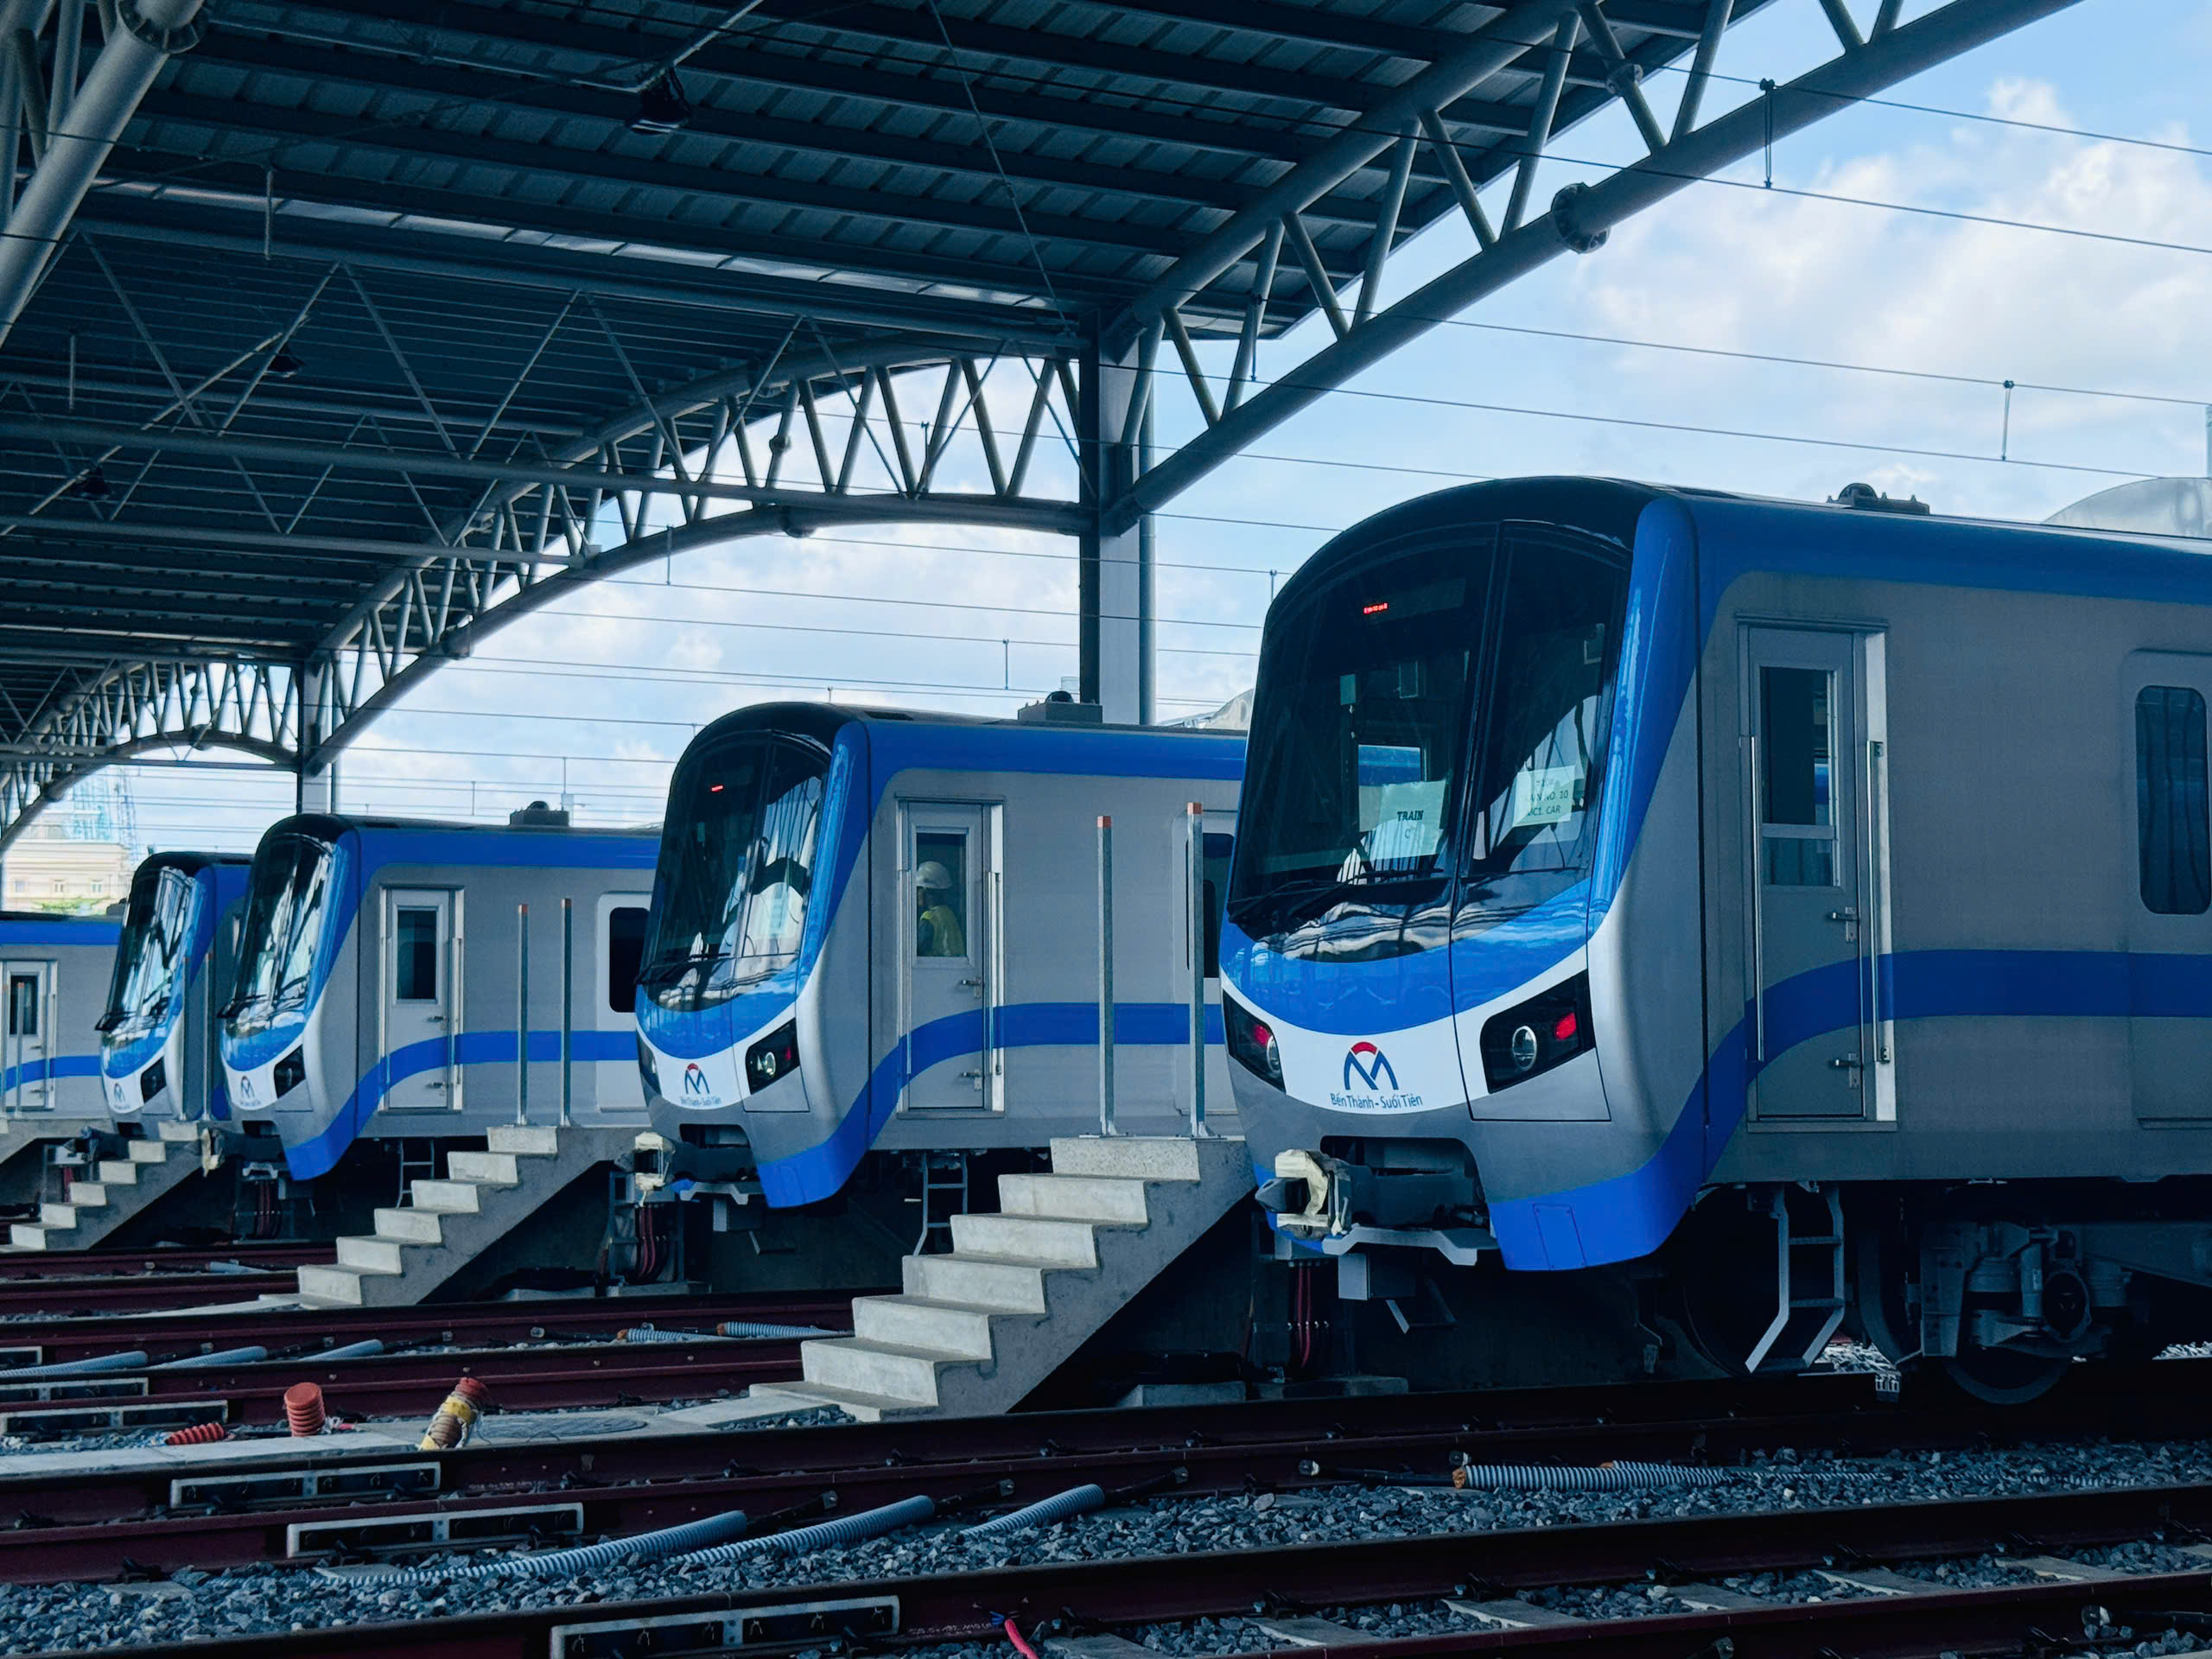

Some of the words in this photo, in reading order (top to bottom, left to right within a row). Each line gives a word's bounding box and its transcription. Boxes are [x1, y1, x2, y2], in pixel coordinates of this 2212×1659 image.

[1559, 790, 1569, 799] 10
[1546, 804, 1560, 815] CAR
[1396, 810, 1424, 822] TRAIN
